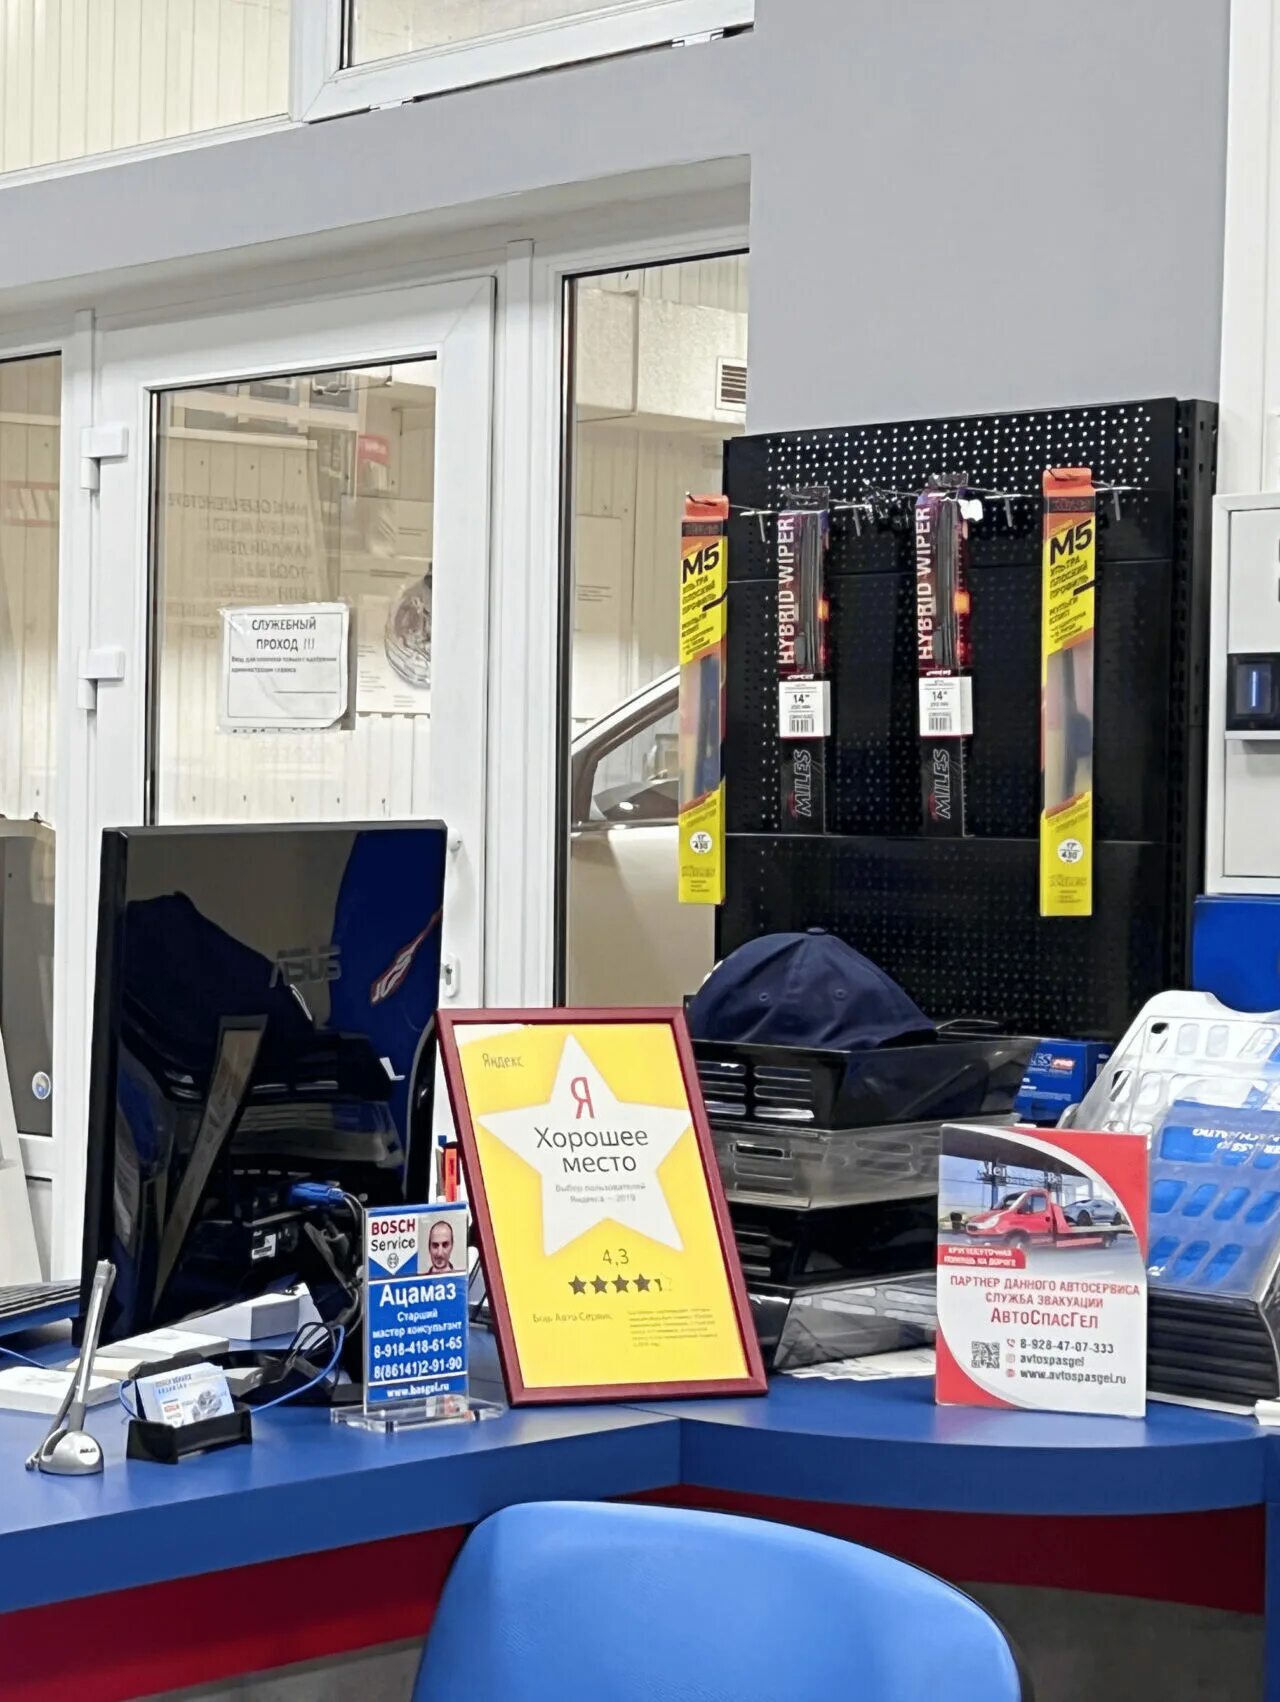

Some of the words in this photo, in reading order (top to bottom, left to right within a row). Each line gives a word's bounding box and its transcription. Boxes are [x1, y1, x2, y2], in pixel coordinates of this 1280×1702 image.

[777, 515, 795, 584] WIPER
[915, 506, 932, 576] WIPER
[251, 616, 317, 632] СЛУЖЕБНЫЙ
[778, 589, 795, 664] HYBRID
[916, 584, 934, 660] HYBRID
[256, 638, 299, 652] ПРОХОД
[793, 748, 812, 817] MILES
[933, 748, 951, 819] MILES
[482, 1052, 525, 1069] Яндекс
[570, 1076, 595, 1119] Я
[534, 1126, 649, 1153] Хорошее
[562, 1154, 637, 1173] место
[371, 1218, 416, 1236] BOSCH
[370, 1237, 416, 1252] Service
[602, 1248, 630, 1266] 4,3
[379, 1282, 457, 1308] Ацамаз
[950, 1275, 1001, 1288] ПАРТНЕР
[1004, 1279, 1056, 1292] ДАННОГО
[1060, 1282, 1141, 1296] АВТОСЕРВИСА
[985, 1293, 1034, 1306] СЛУЖБА
[397, 1308, 438, 1323] Старший
[372, 1327, 406, 1339] мастер
[373, 1336, 463, 1359] 8-918-418-61-65
[1019, 1338, 1114, 1355] 8-928-47-07-333
[373, 1356, 463, 1382] 8(86141)2-91-90
[1019, 1355, 1085, 1368] avtospasgel
[1019, 1369, 1127, 1385] www.avtospasgel.ru
